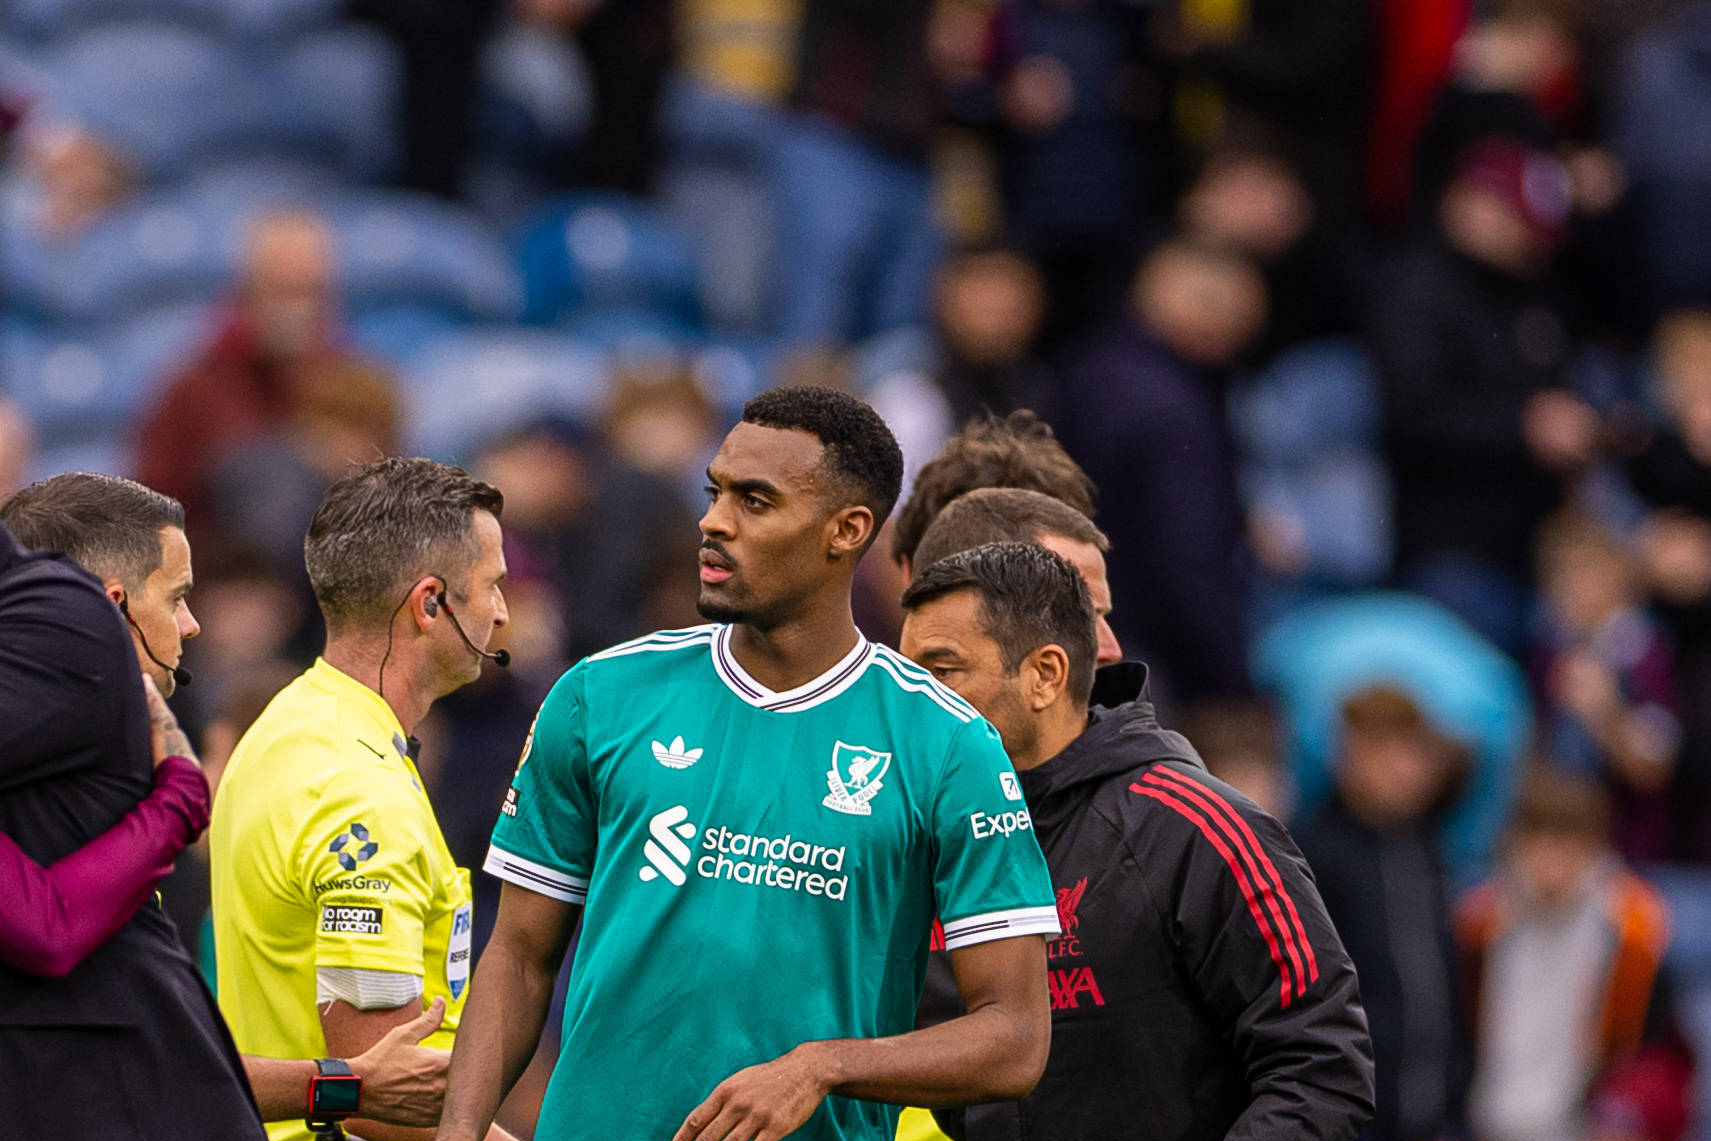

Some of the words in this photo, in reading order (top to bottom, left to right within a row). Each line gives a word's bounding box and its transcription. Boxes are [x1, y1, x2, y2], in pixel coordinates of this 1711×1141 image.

[970, 807, 1033, 839] Expe
[702, 826, 846, 871] standard
[697, 853, 849, 901] chartered
[335, 920, 382, 934] racism
[336, 908, 376, 921] room
